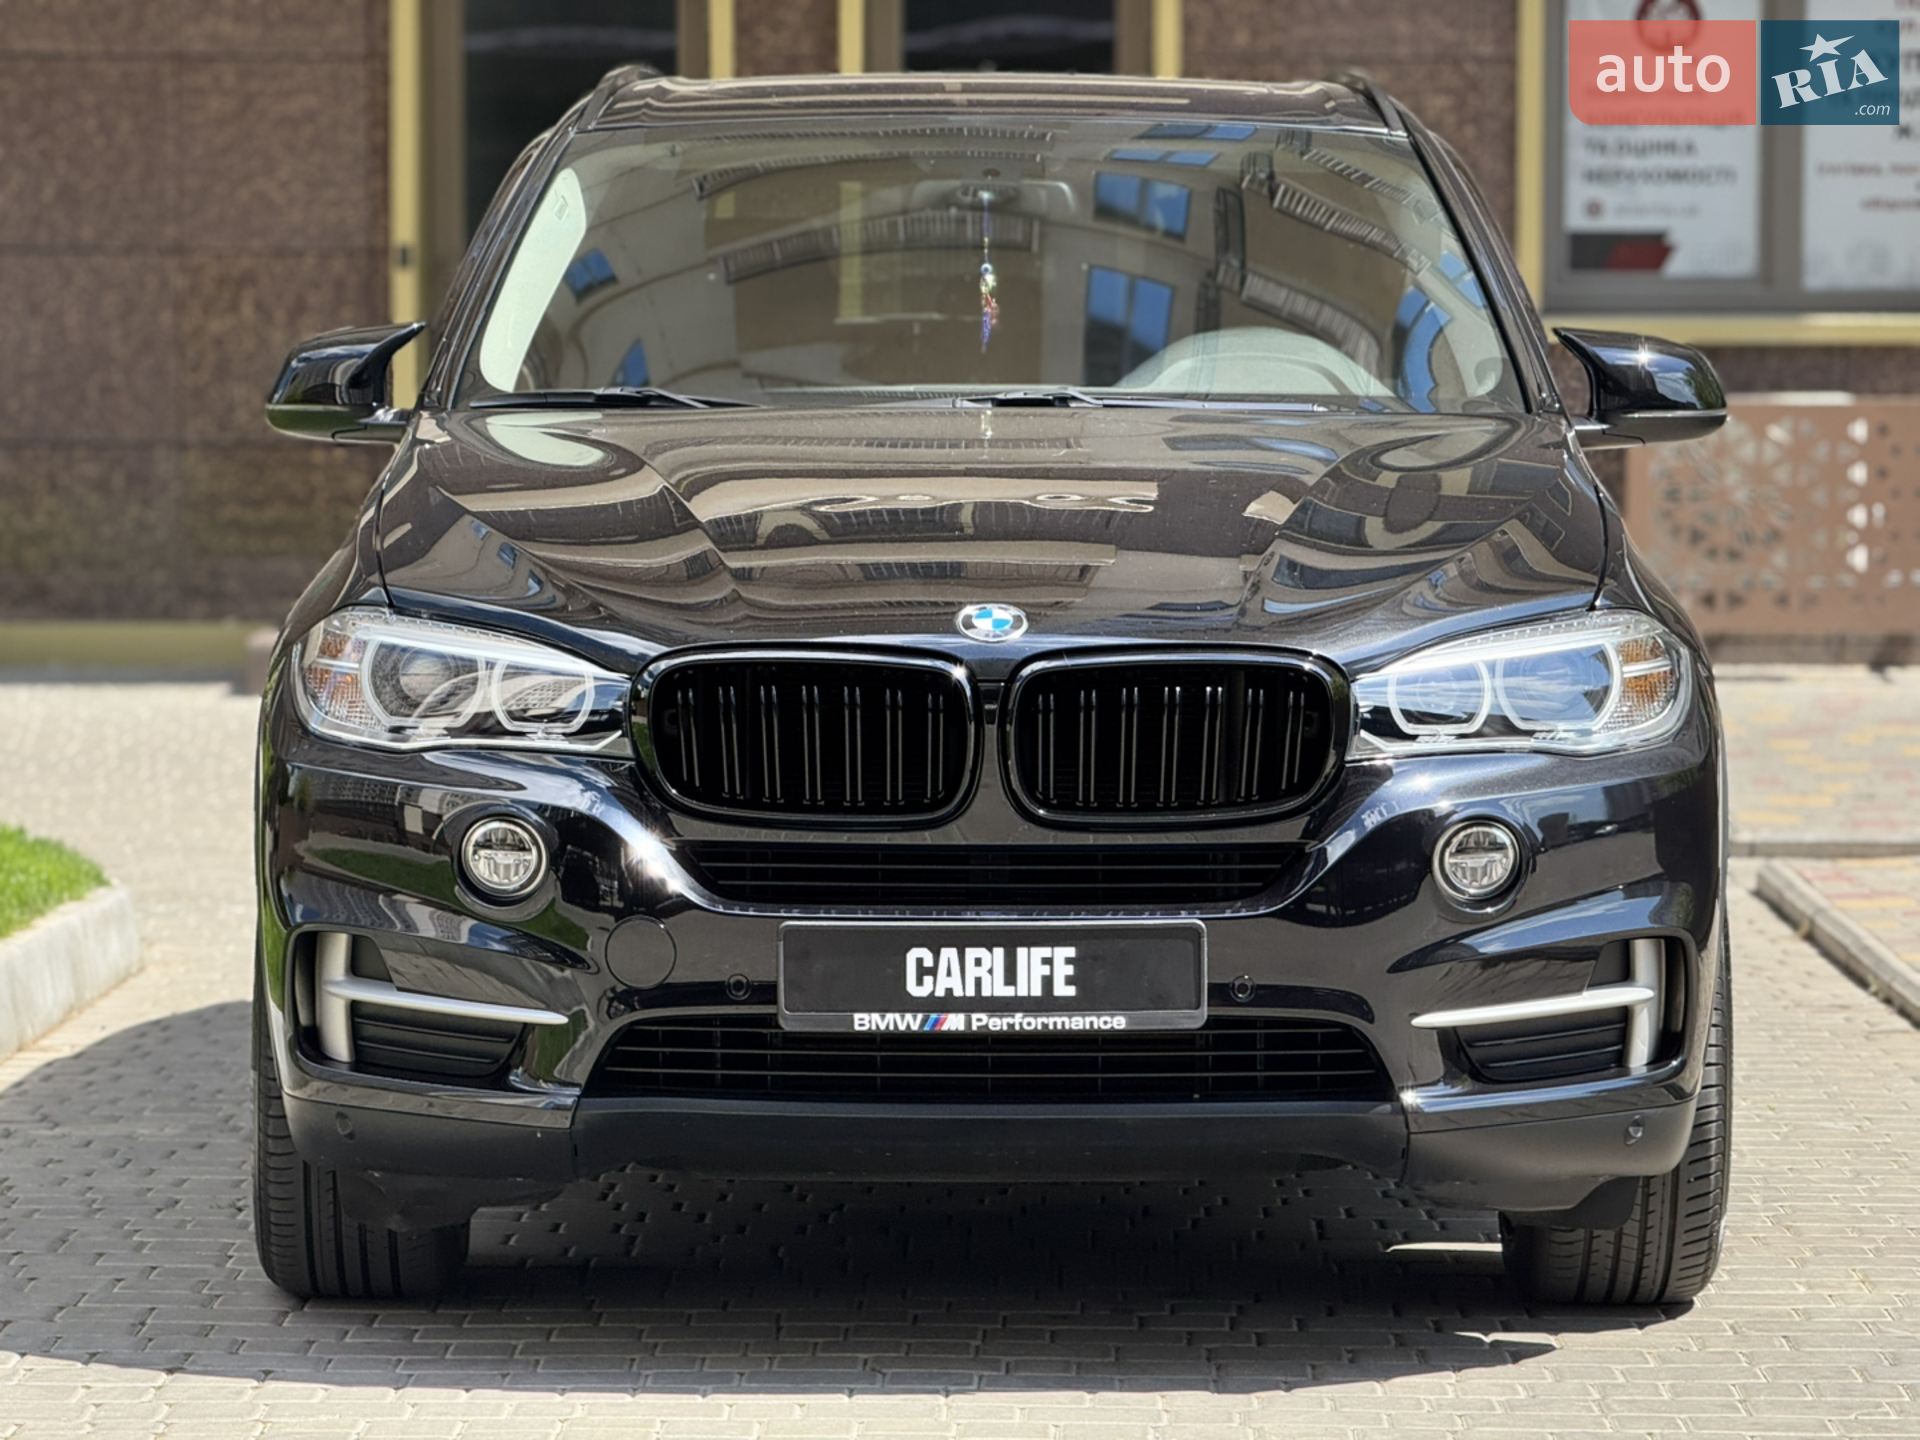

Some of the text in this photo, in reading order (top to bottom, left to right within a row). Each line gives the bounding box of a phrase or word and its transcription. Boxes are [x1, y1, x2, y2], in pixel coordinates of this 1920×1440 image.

[905, 946, 1076, 998] CARLIFE
[852, 1012, 923, 1032] BMW
[971, 1012, 1127, 1031] Performance
